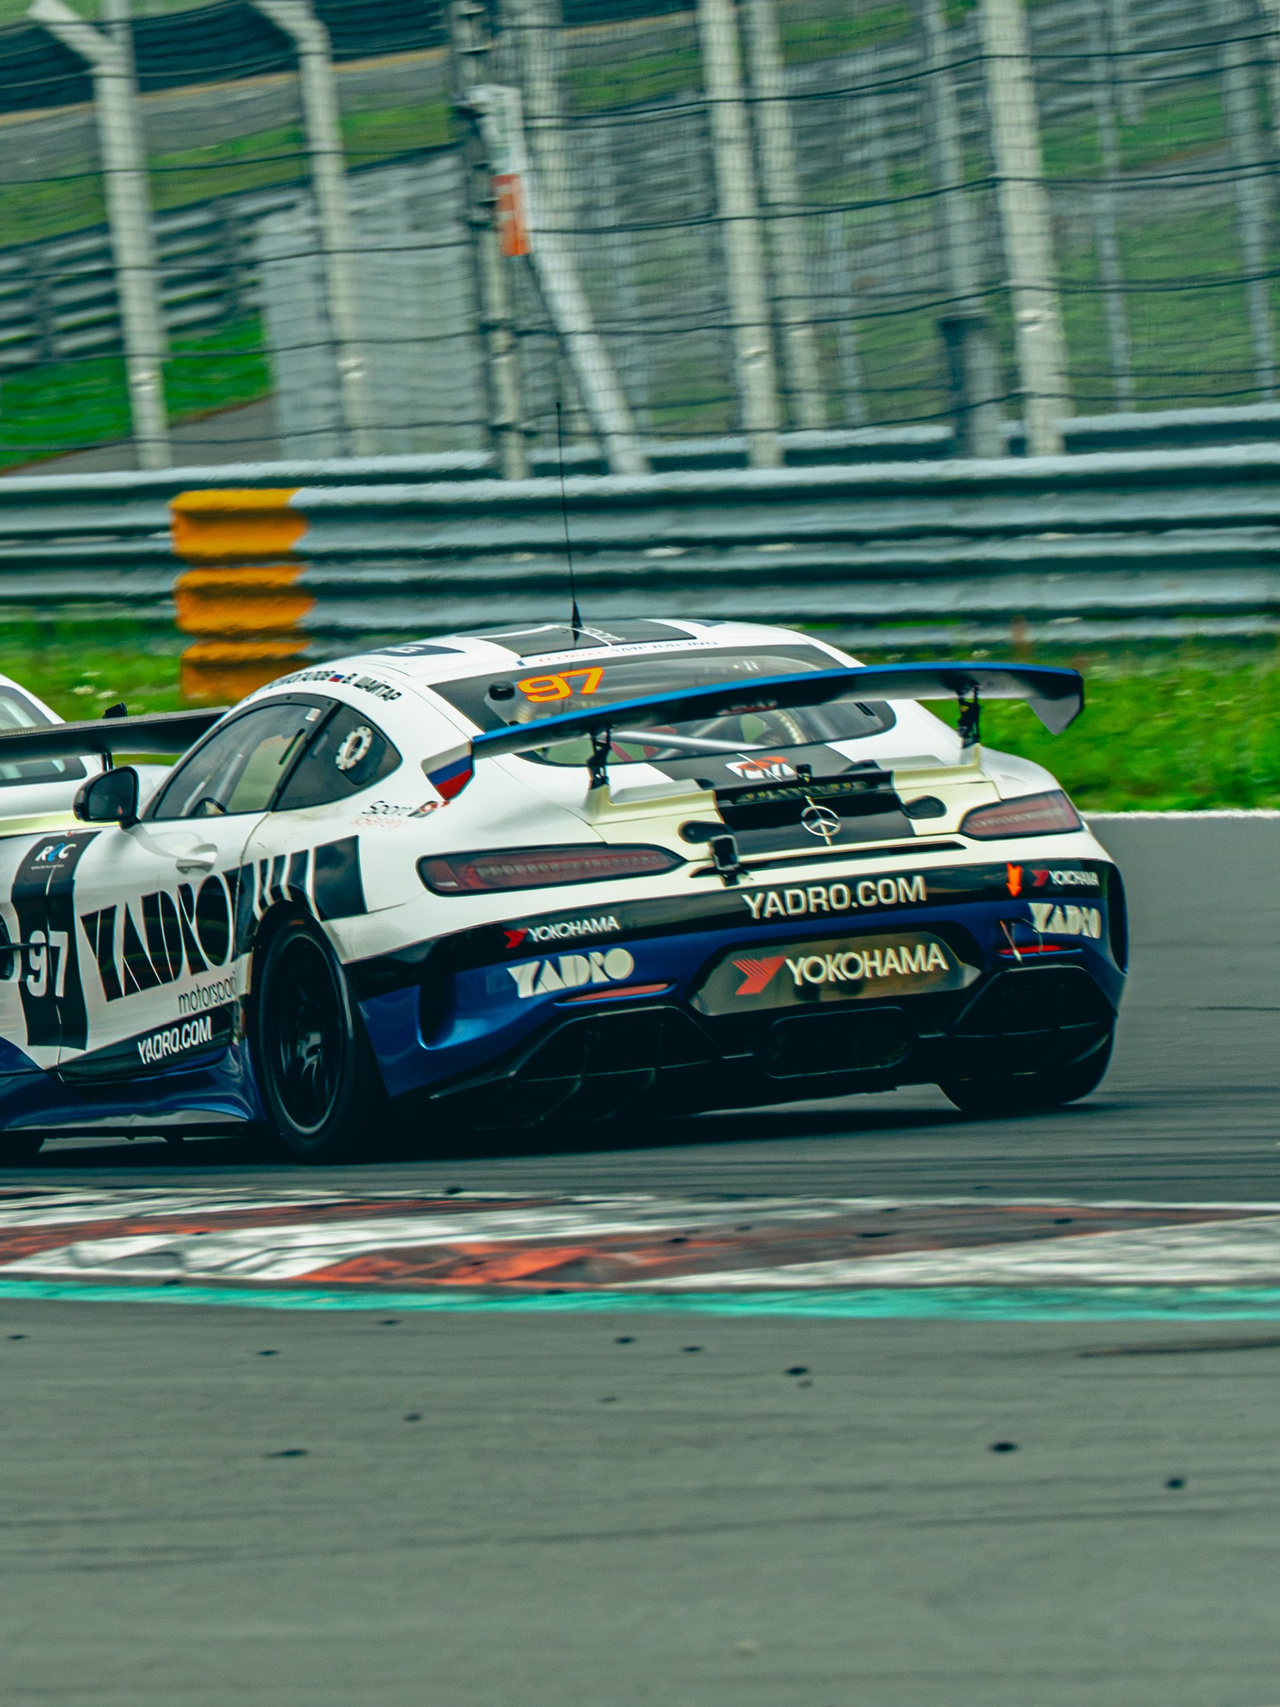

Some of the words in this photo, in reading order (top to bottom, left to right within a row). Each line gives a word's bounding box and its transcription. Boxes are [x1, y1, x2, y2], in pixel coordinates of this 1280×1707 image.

[517, 666, 604, 703] 97
[741, 875, 927, 919] YADRO.COM
[1048, 870, 1100, 886] YOKOHAMA
[80, 874, 233, 1003] YADRO
[528, 915, 620, 942] YOKOHAMA
[1027, 902, 1101, 939] YADRO
[26, 930, 69, 998] 97
[506, 947, 634, 998] YADRO
[785, 943, 949, 986] YOKOHAMA
[137, 1015, 212, 1064] YADRO.COM
